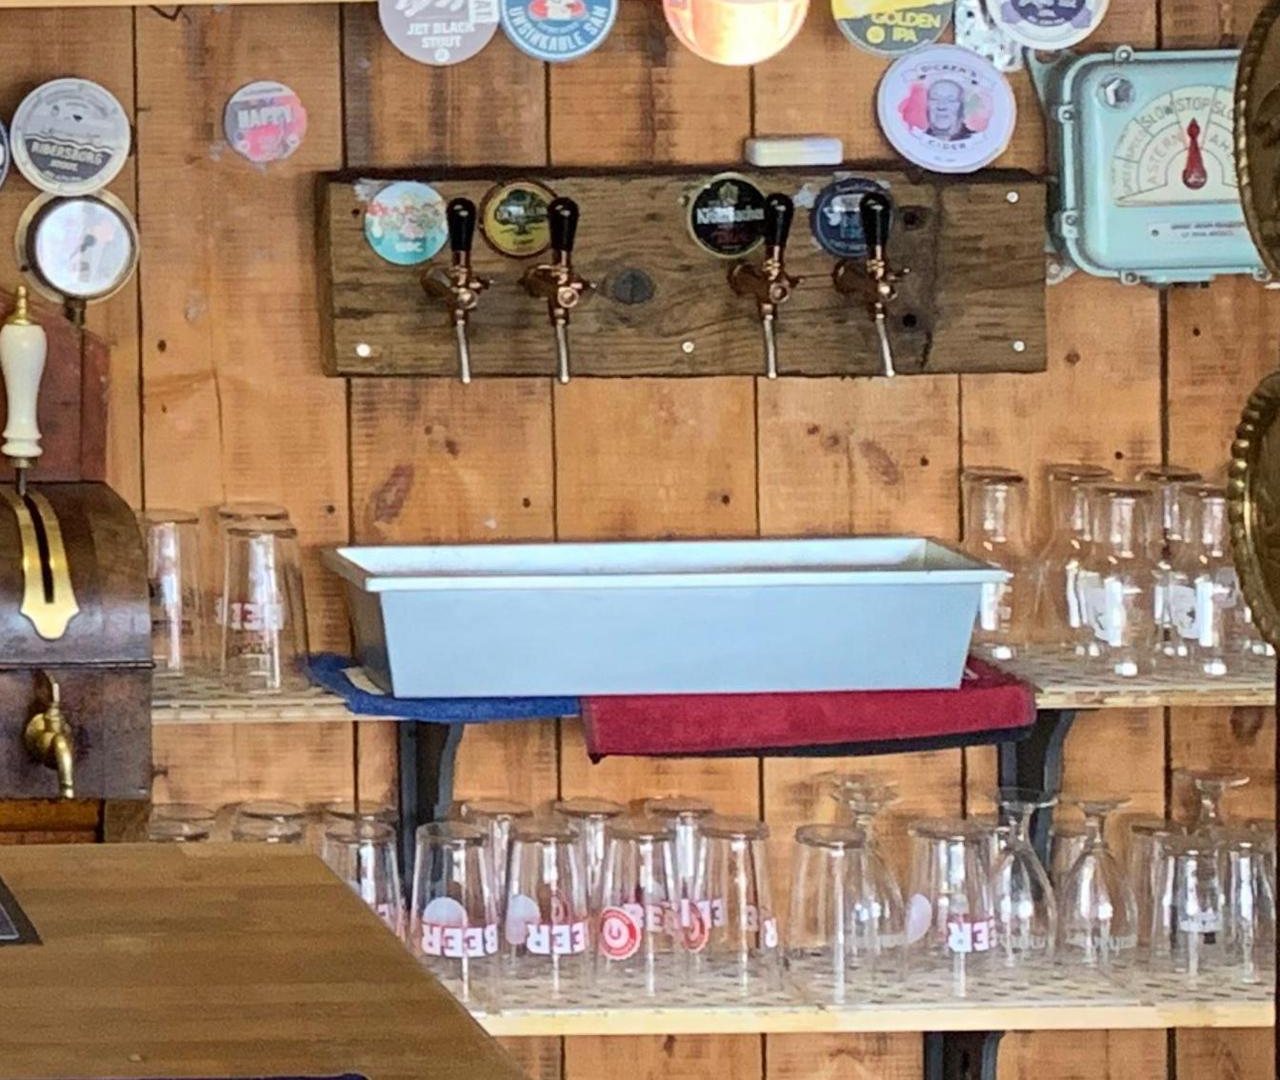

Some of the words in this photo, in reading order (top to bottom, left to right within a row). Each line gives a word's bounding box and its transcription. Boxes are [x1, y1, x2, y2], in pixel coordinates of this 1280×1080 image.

[407, 20, 432, 36] JET
[433, 20, 476, 35] BLACK
[871, 12, 940, 28] GOLDEN
[508, 4, 583, 54] UNSINKABLE
[892, 27, 918, 42] IPA
[421, 35, 463, 50] STOUT
[1140, 104, 1176, 130] SLOW
[1176, 97, 1212, 113] STOP
[421, 923, 498, 958] BEER
